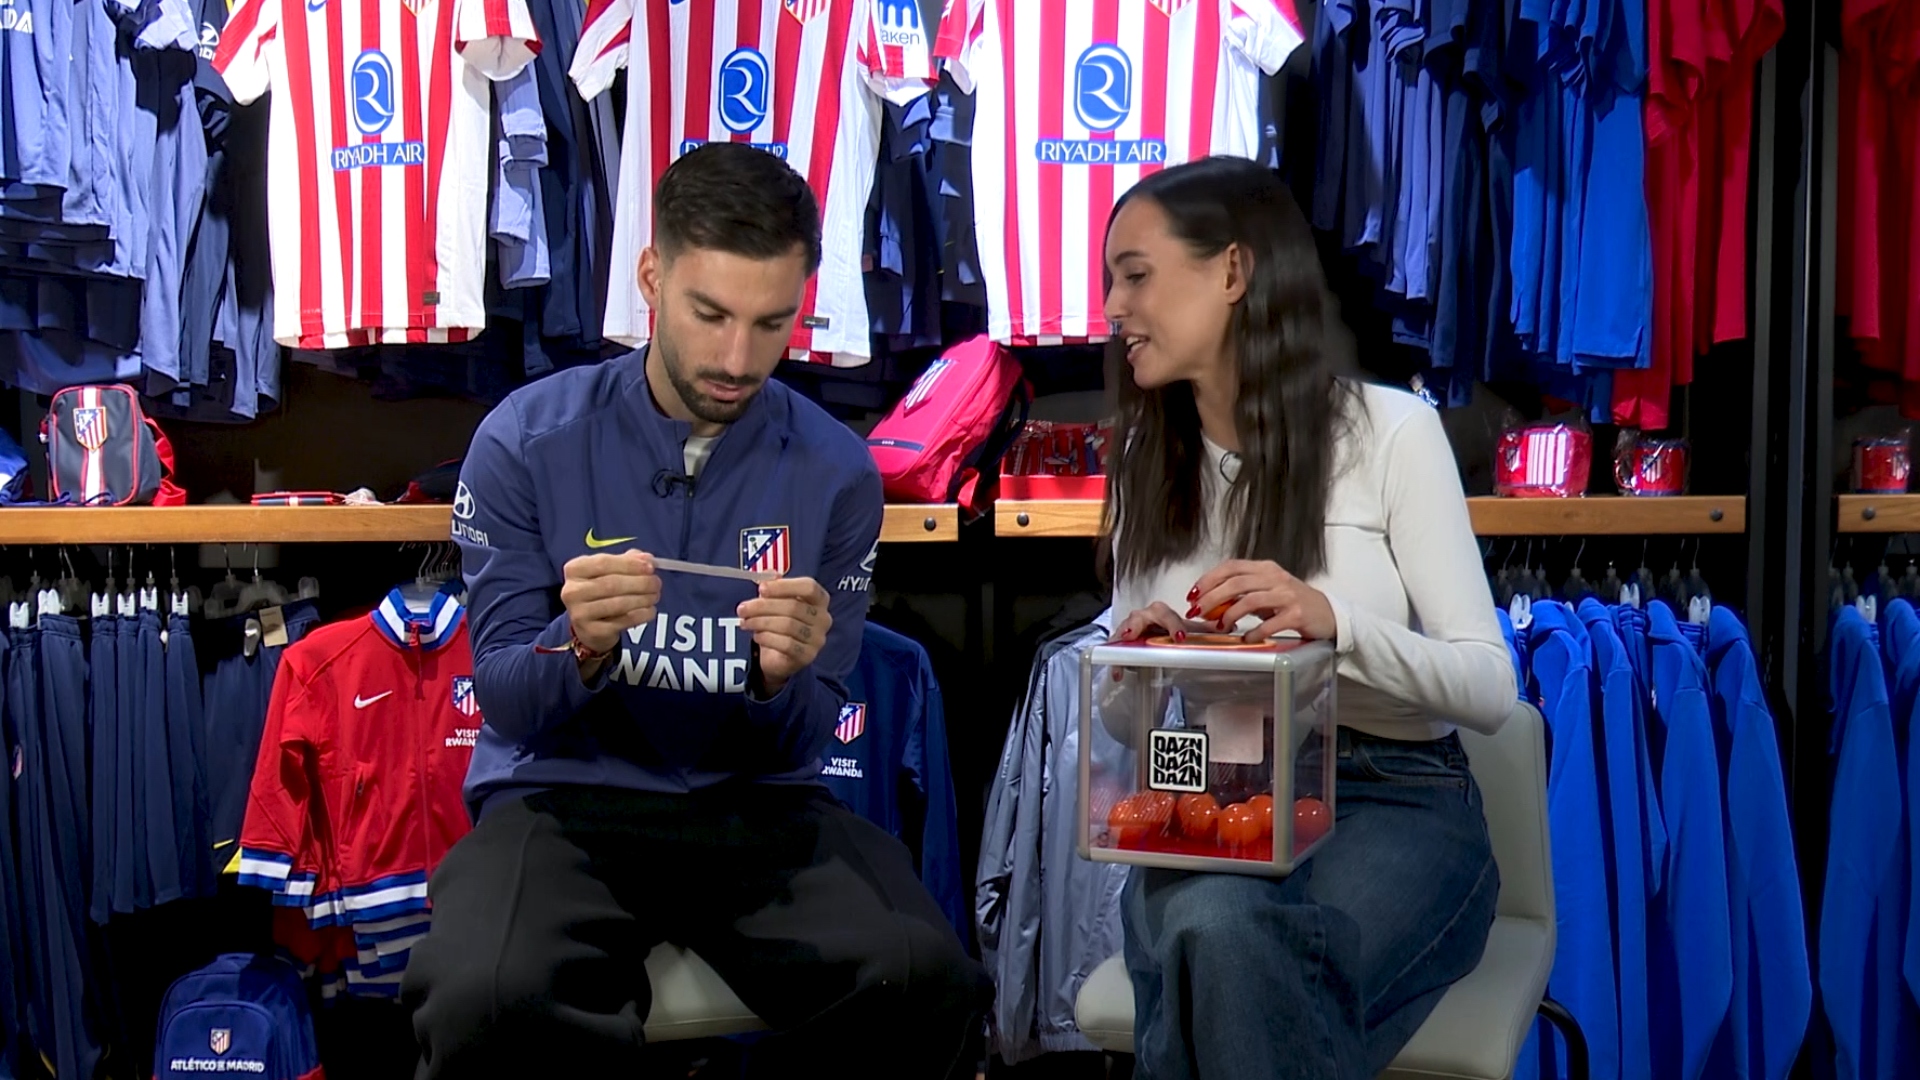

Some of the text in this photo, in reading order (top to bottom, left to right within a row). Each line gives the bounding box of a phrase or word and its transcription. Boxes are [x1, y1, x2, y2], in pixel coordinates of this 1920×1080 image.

[881, 30, 920, 45] aken
[335, 143, 423, 169] RIYADH AIR
[1041, 141, 1162, 162] RIYADH AIR
[451, 519, 489, 547] UNDAI
[627, 612, 742, 652] VISIT
[609, 648, 747, 693] WAND
[445, 736, 476, 748] RWAN
[454, 728, 480, 738] VISIT
[1154, 735, 1203, 756] DAZN
[831, 756, 858, 769] VISIT
[1154, 749, 1203, 772] DAZN
[1154, 766, 1203, 788] DAZN
[170, 1057, 216, 1072] ATLÉTICO
[226, 1060, 265, 1074] MADRID
